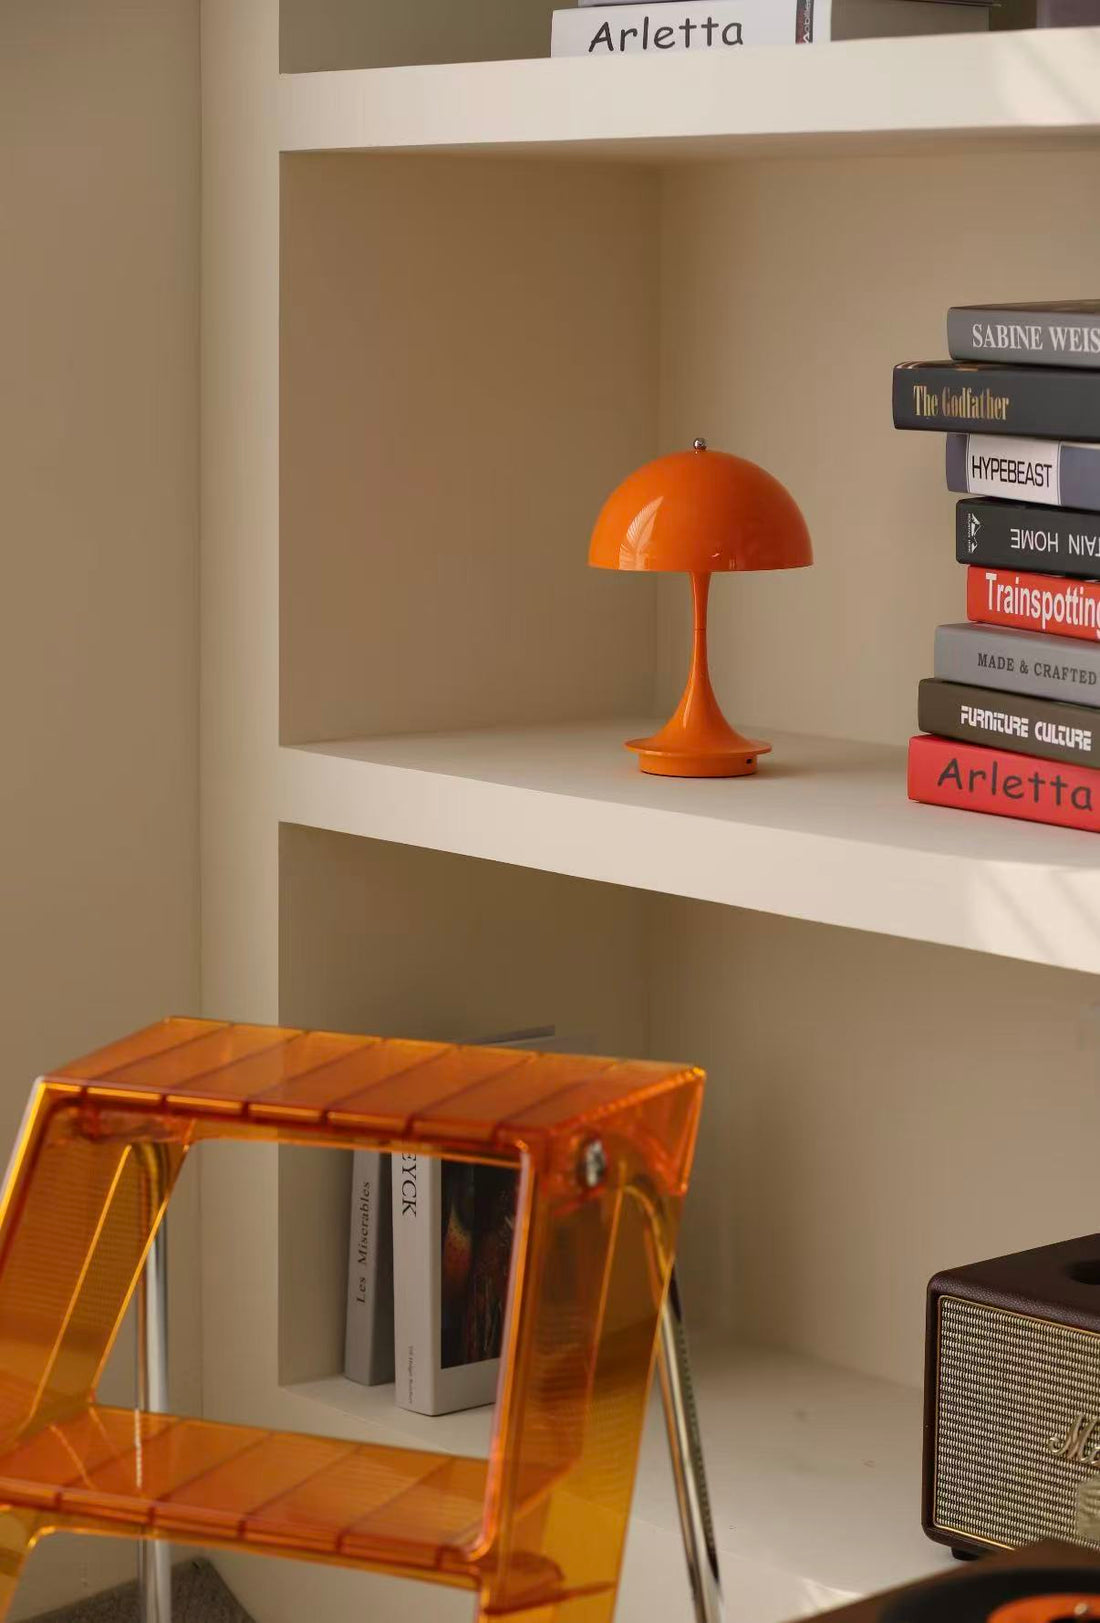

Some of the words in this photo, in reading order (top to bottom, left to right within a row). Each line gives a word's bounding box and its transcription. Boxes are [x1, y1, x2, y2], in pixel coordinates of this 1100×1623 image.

[588, 16, 744, 53] Arletta
[972, 323, 1043, 350] SABINE
[1048, 326, 1100, 354] WEIS
[913, 385, 939, 417] The
[941, 387, 1010, 421] Godfather
[971, 455, 1052, 487] HYPEBEAST
[1010, 528, 1058, 553] HOME
[977, 652, 1015, 672] MADE
[1019, 659, 1029, 675] &
[1033, 661, 1097, 685] CRAFTED
[960, 705, 1029, 738] FURNITURE
[1034, 720, 1092, 752] CULTURE
[937, 758, 1093, 812] Arletta
[357, 1181, 371, 1267] Miserables
[356, 1276, 367, 1304] Les
